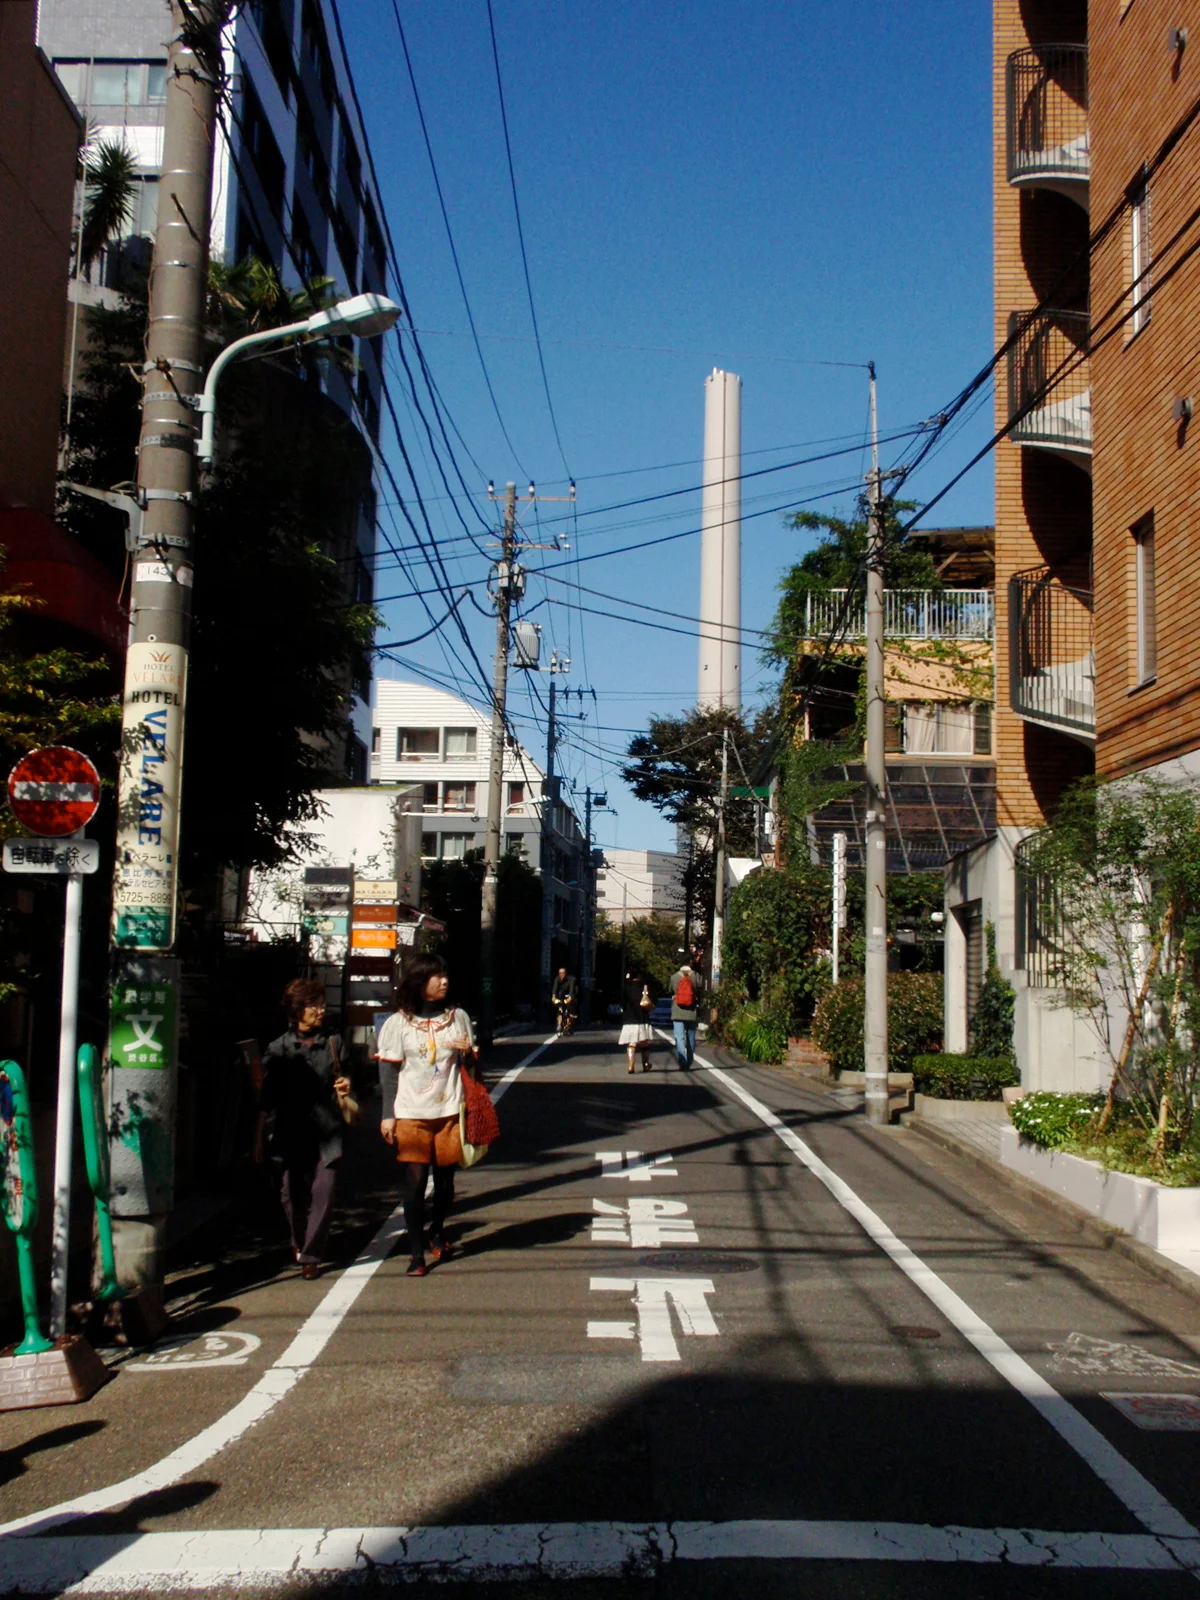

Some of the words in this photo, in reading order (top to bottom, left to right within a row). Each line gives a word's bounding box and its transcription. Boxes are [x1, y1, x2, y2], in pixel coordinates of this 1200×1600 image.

[143, 663, 175, 671] HOTEL
[131, 690, 181, 706] HOTEL
[138, 709, 167, 846] VELARE
[11, 846, 91, 866] 自転車を除く
[122, 1008, 164, 1052] 文
[127, 1053, 158, 1063] 渋谷区
